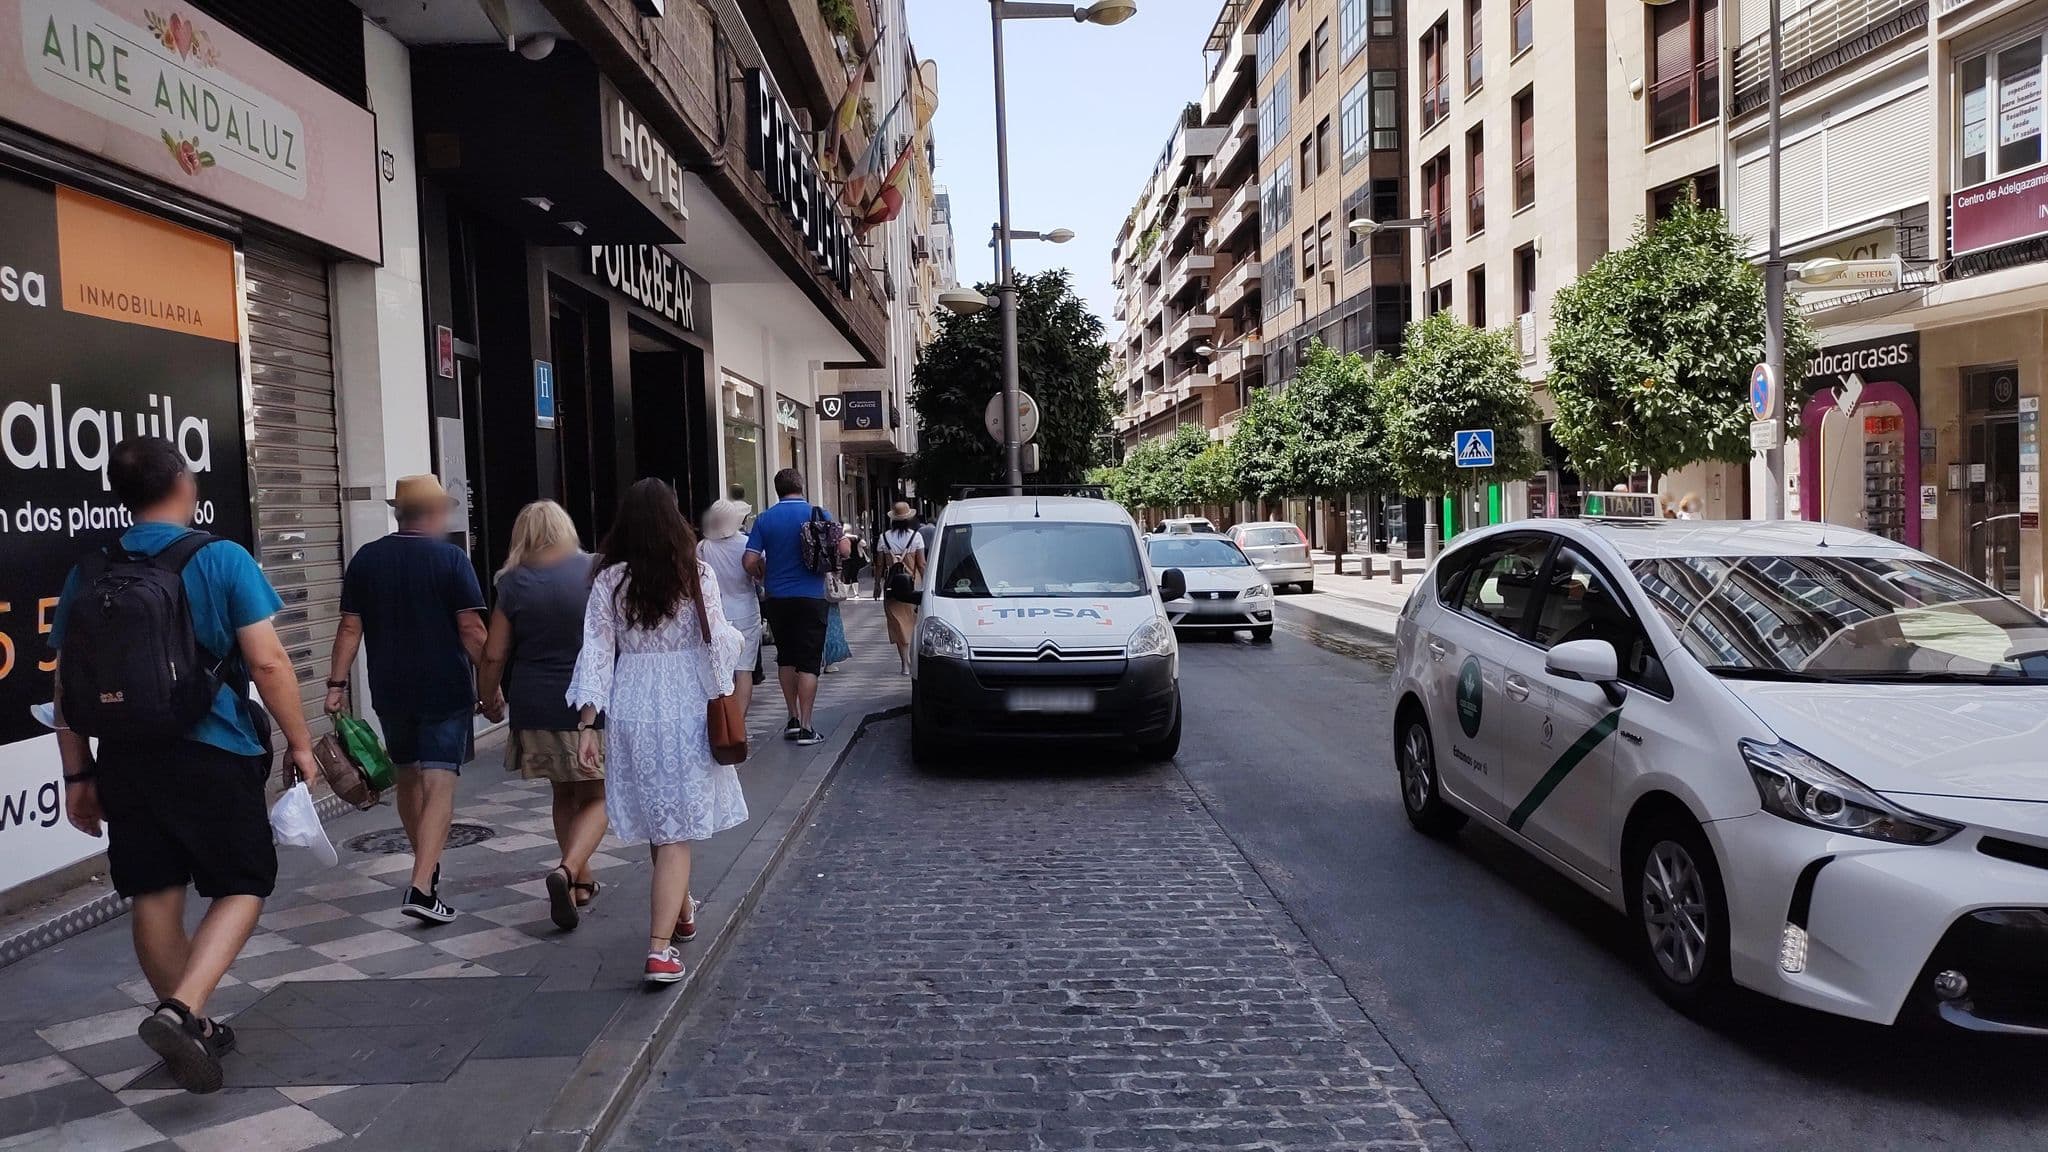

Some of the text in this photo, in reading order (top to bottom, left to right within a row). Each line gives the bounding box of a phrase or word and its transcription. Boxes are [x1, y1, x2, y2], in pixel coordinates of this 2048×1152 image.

[43, 14, 297, 171] AIRE ANDALUZ
[611, 99, 689, 220] HOTEL
[1958, 195, 1985, 208] Centro
[1986, 189, 1997, 200] de
[80, 283, 203, 327] INMOBILIARIA
[591, 245, 695, 331] PULL&BEAR
[1805, 343, 1908, 377] odocarcasas
[15, 501, 62, 532] dos
[1607, 496, 1640, 513] TAXI
[992, 607, 1102, 619] TIPSA
